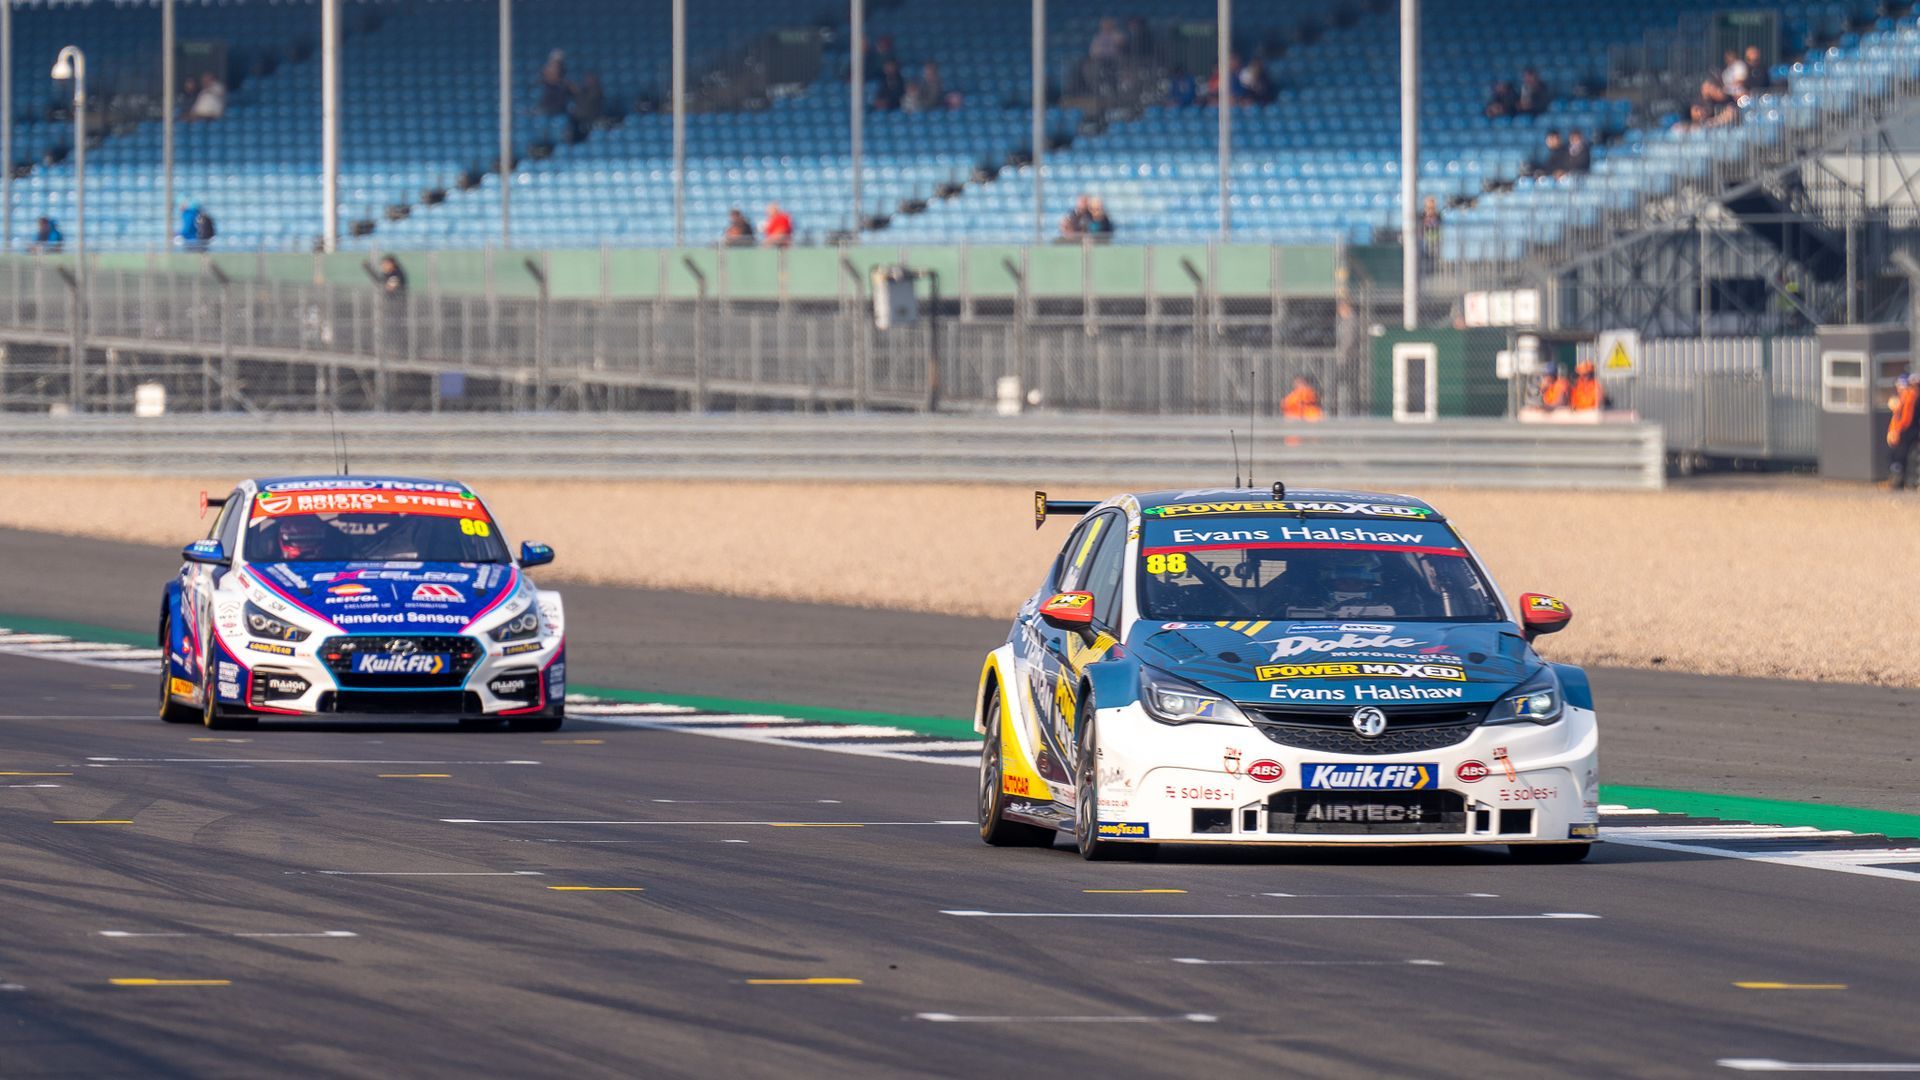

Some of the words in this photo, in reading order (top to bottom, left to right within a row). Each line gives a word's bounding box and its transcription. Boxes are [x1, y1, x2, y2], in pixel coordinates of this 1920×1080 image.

[298, 493, 390, 504] BRISTOL
[394, 495, 477, 510] STREET
[298, 502, 373, 511] MOTORS
[1164, 501, 1288, 515] POWER
[1293, 502, 1415, 516] MAXED
[460, 518, 490, 537] 80
[1173, 527, 1270, 543] Evans
[1281, 526, 1424, 544] Halshaw
[1146, 553, 1187, 574] 88
[332, 612, 403, 625] Hansford
[407, 612, 470, 625] Sensors
[1250, 633, 1430, 662] Doble
[1331, 652, 1462, 662] MOTORCYCLES
[1263, 665, 1360, 678] POWER
[1363, 663, 1461, 678] MAXED
[1270, 684, 1346, 700] Evans
[1353, 684, 1463, 700] Halshaw
[1251, 766, 1281, 776] ABS
[1460, 767, 1487, 776] ABS
[1181, 785, 1235, 800] sales-i
[1513, 786, 1558, 801] sales-i
[1305, 804, 1406, 821] AIRTEC
